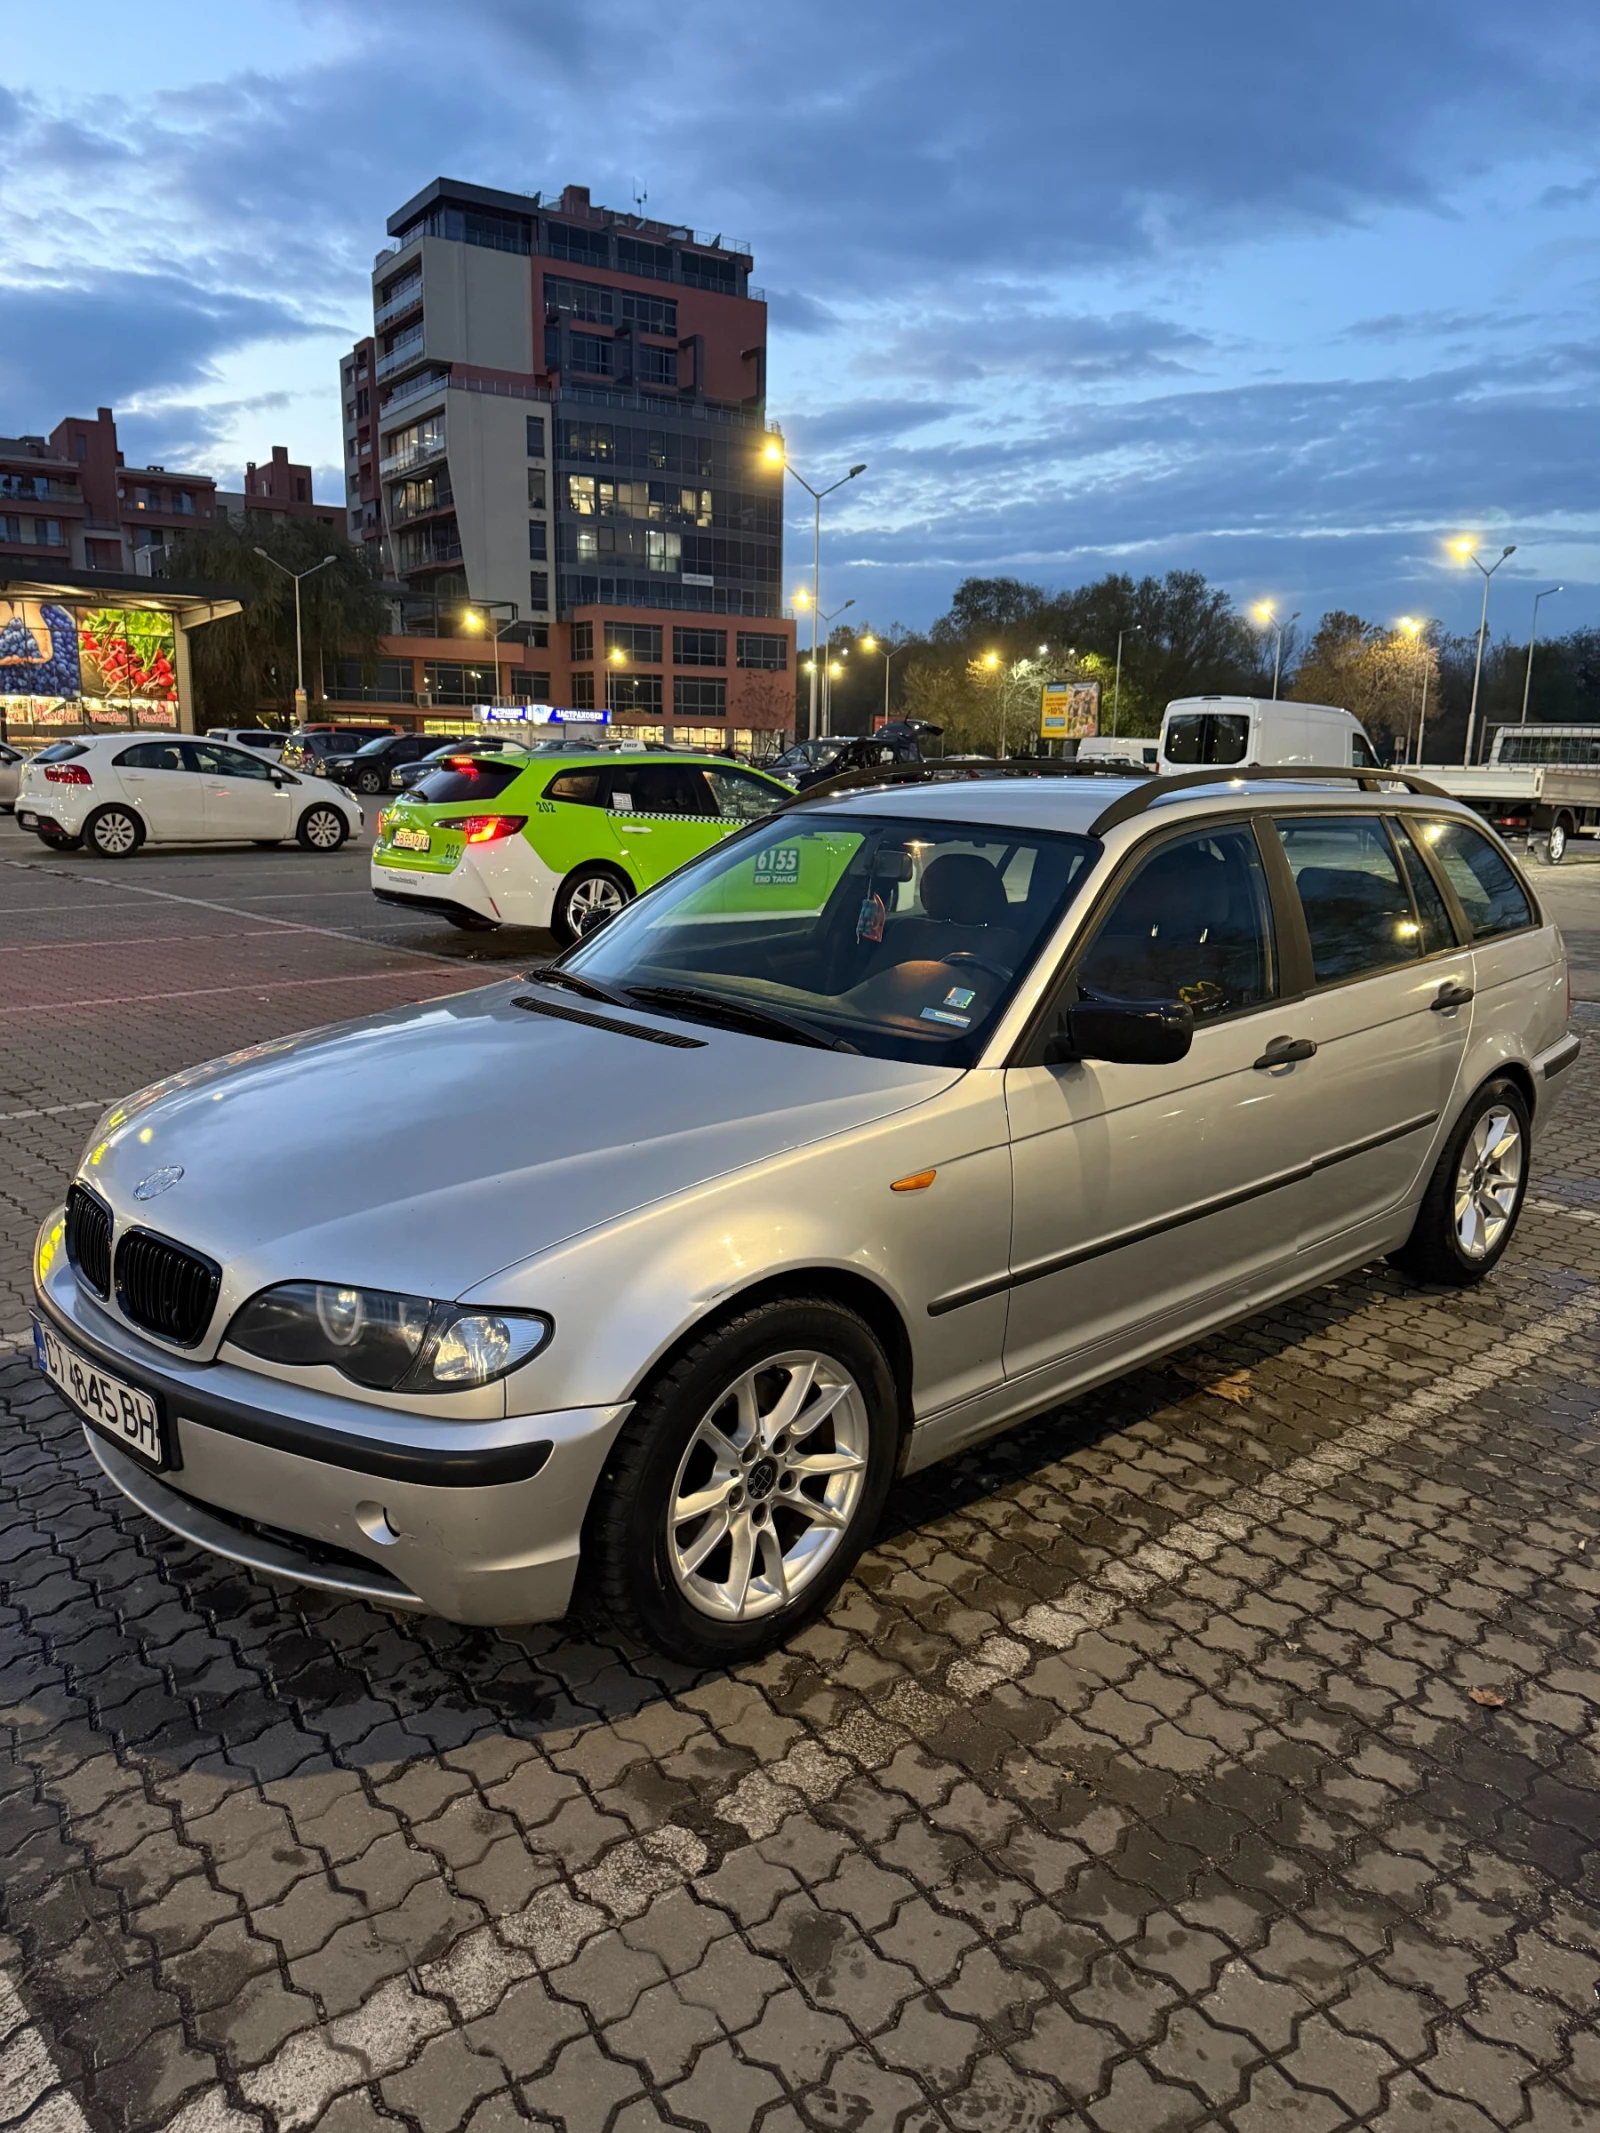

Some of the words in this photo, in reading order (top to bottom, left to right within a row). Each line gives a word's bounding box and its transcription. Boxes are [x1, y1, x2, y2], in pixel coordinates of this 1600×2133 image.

[555, 709, 604, 720] ЗАСТРАХОВКИ
[535, 801, 557, 813] 202
[445, 843, 460, 859] 202
[757, 850, 797, 870] 6155
[118, 1388, 156, 1452] BH
